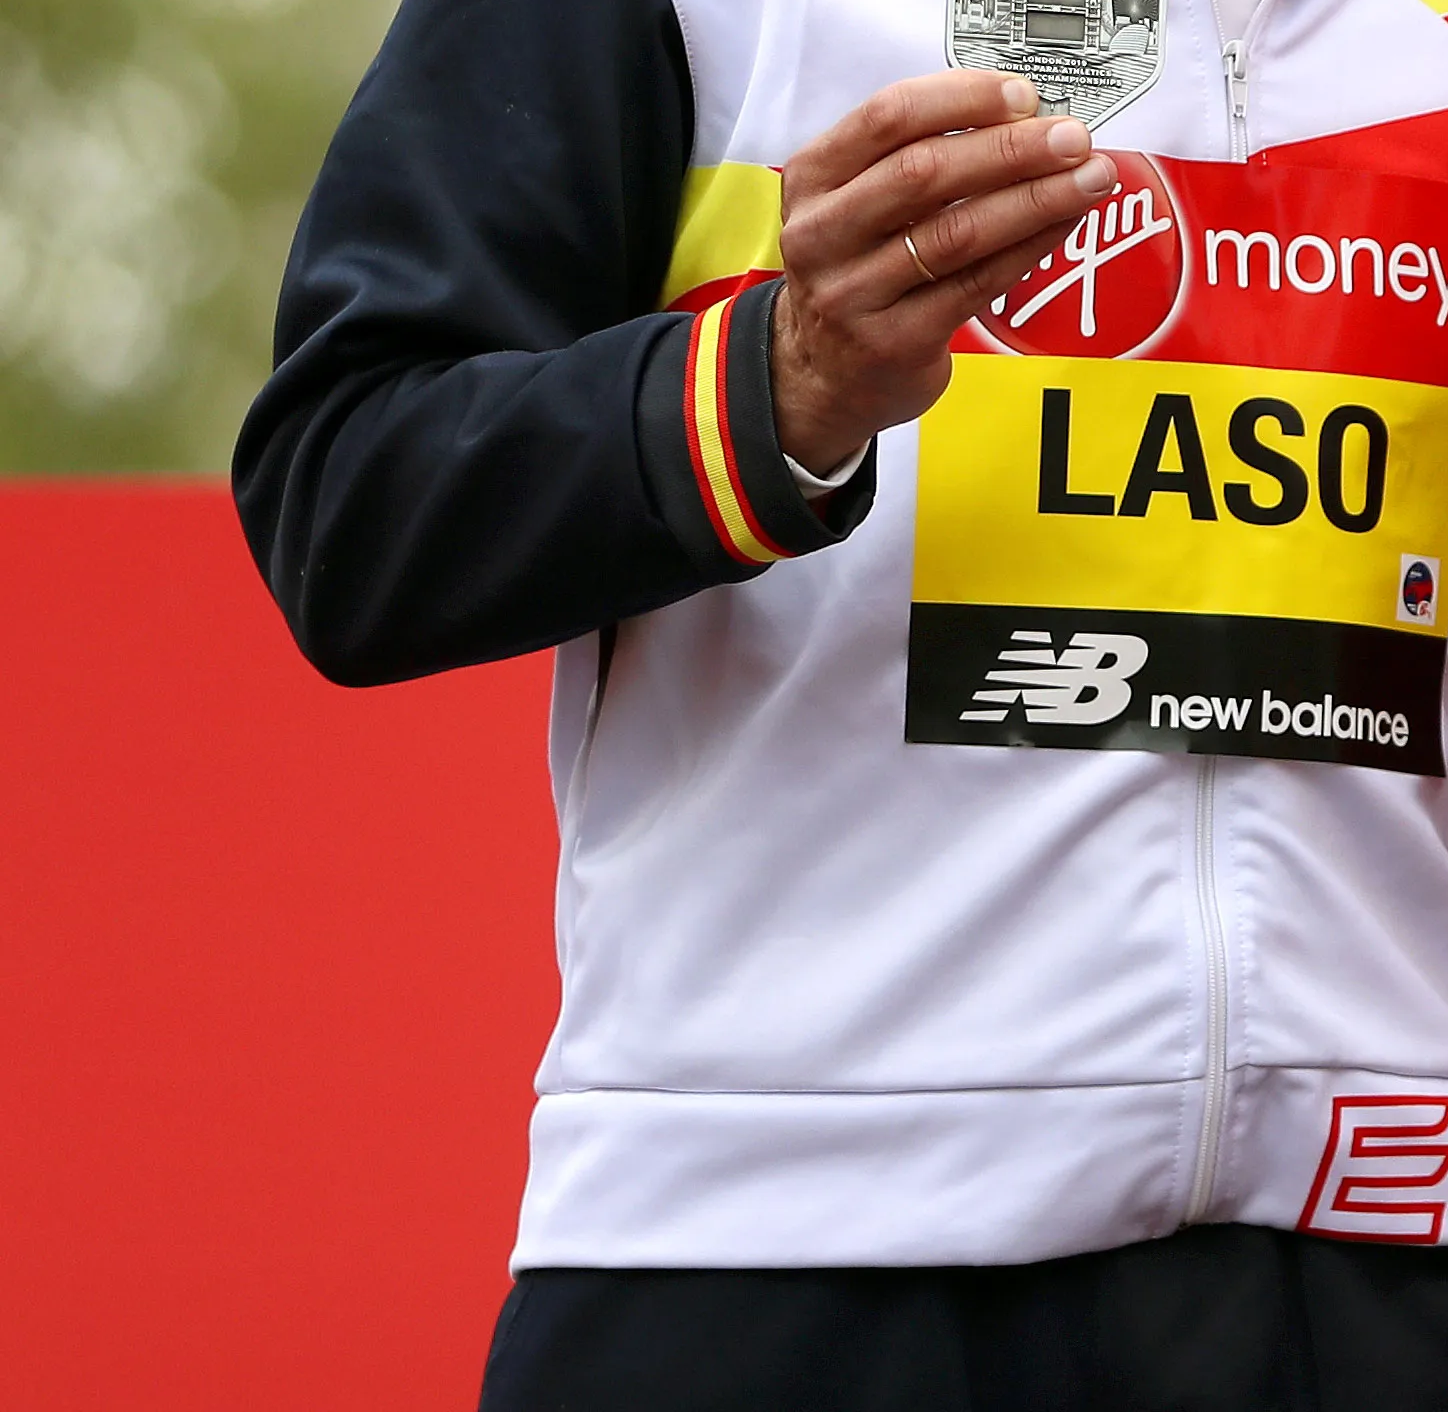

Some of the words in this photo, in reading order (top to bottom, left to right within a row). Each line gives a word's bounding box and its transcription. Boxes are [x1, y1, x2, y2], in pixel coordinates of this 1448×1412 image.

[997, 62, 1031, 72] WORLD
[1033, 65, 1060, 74] PARA
[1060, 67, 1113, 77] ATHLETICS
[1022, 55, 1062, 66] LONDON
[1037, 387, 1391, 535] LASO
[1149, 693, 1254, 734] new
[1260, 689, 1410, 748] balance
